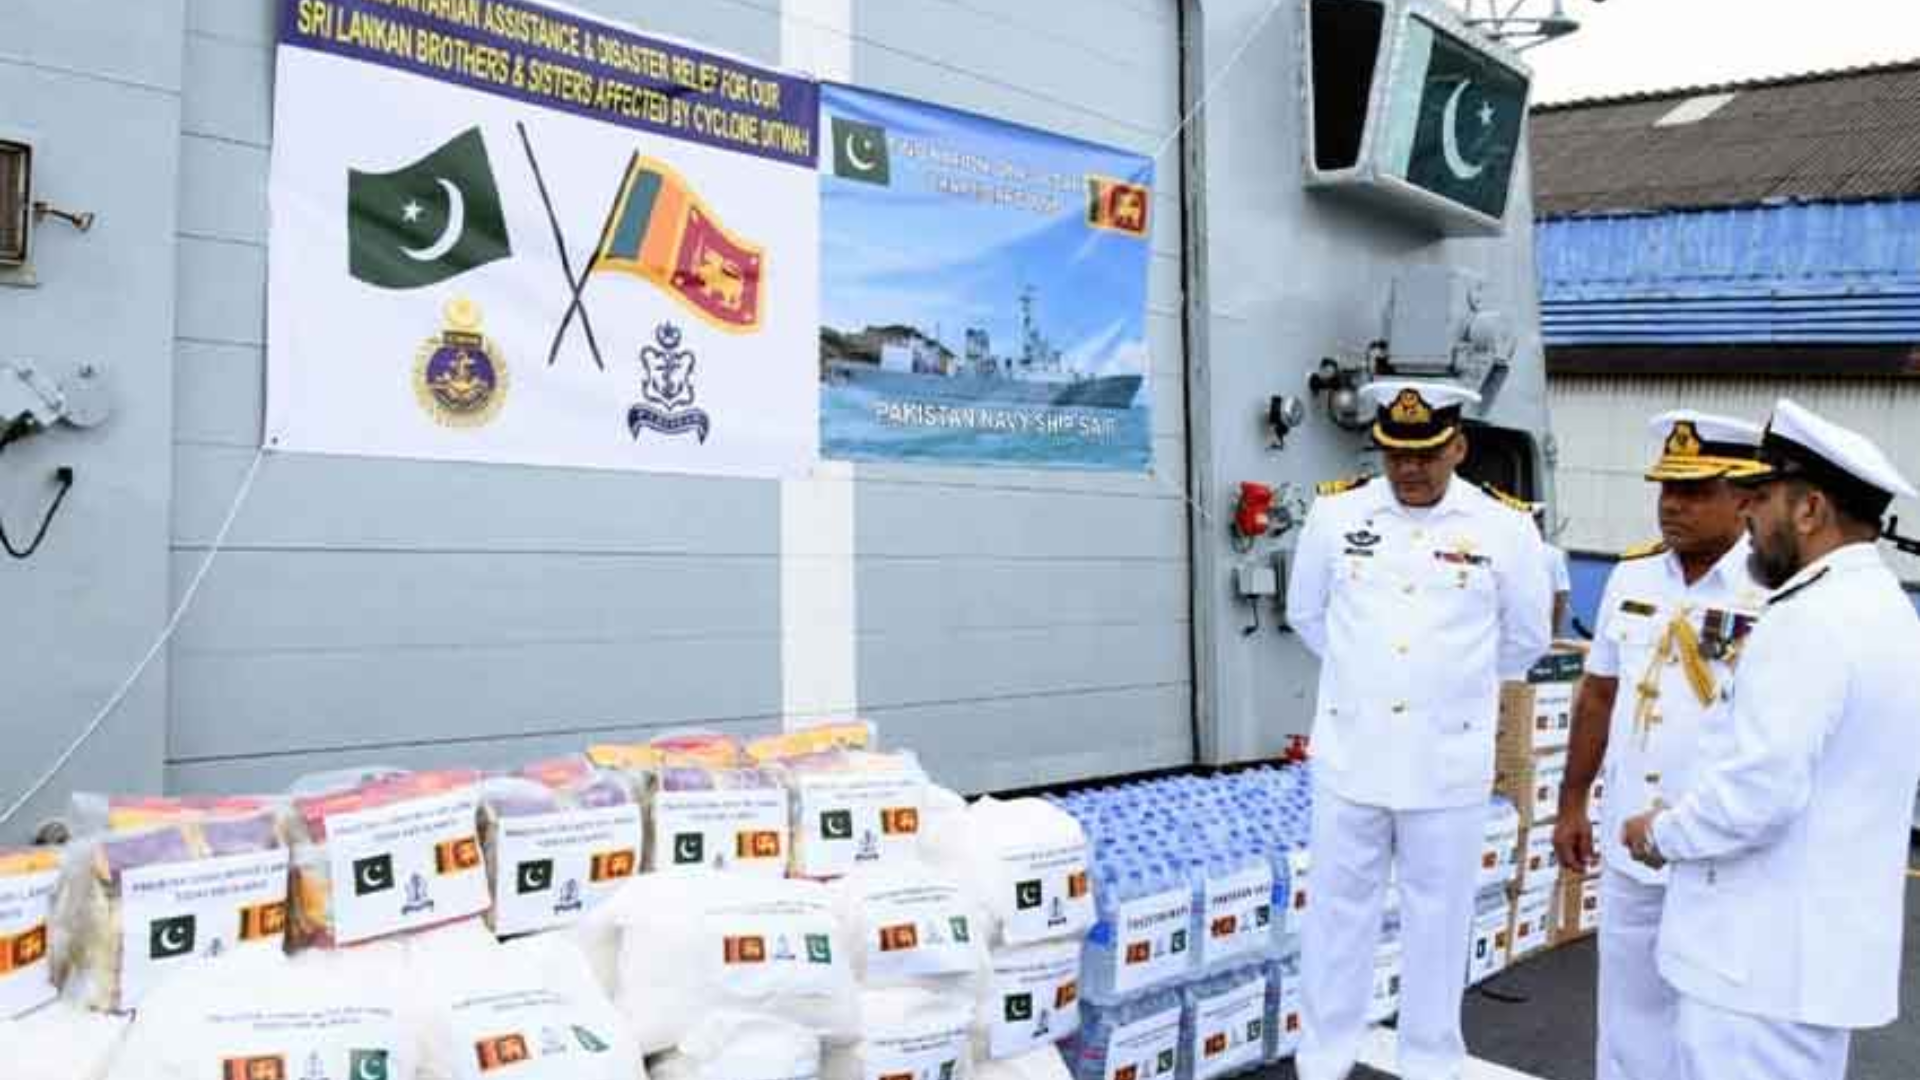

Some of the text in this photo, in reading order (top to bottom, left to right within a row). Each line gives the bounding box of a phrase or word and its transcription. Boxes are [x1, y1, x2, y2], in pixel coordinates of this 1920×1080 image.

[297, 0, 332, 39] SRI
[335, 6, 412, 59] LANKAN
[415, 28, 510, 85] BROTHERS
[512, 54, 525, 88] &
[527, 58, 593, 105] SISTERS
[594, 76, 669, 124] AFFECTED
[671, 96, 690, 132] BY
[693, 101, 759, 146] CYCLONE
[483, 1, 580, 57] ASSISTANCE
[598, 34, 669, 82] DISASTER
[672, 54, 720, 94] RELIEF
[721, 68, 750, 103] FOR
[751, 78, 781, 111] OUR
[874, 401, 976, 430] PAKISTAN
[979, 407, 1030, 433] NAVY
[1034, 410, 1075, 433] SHIP
